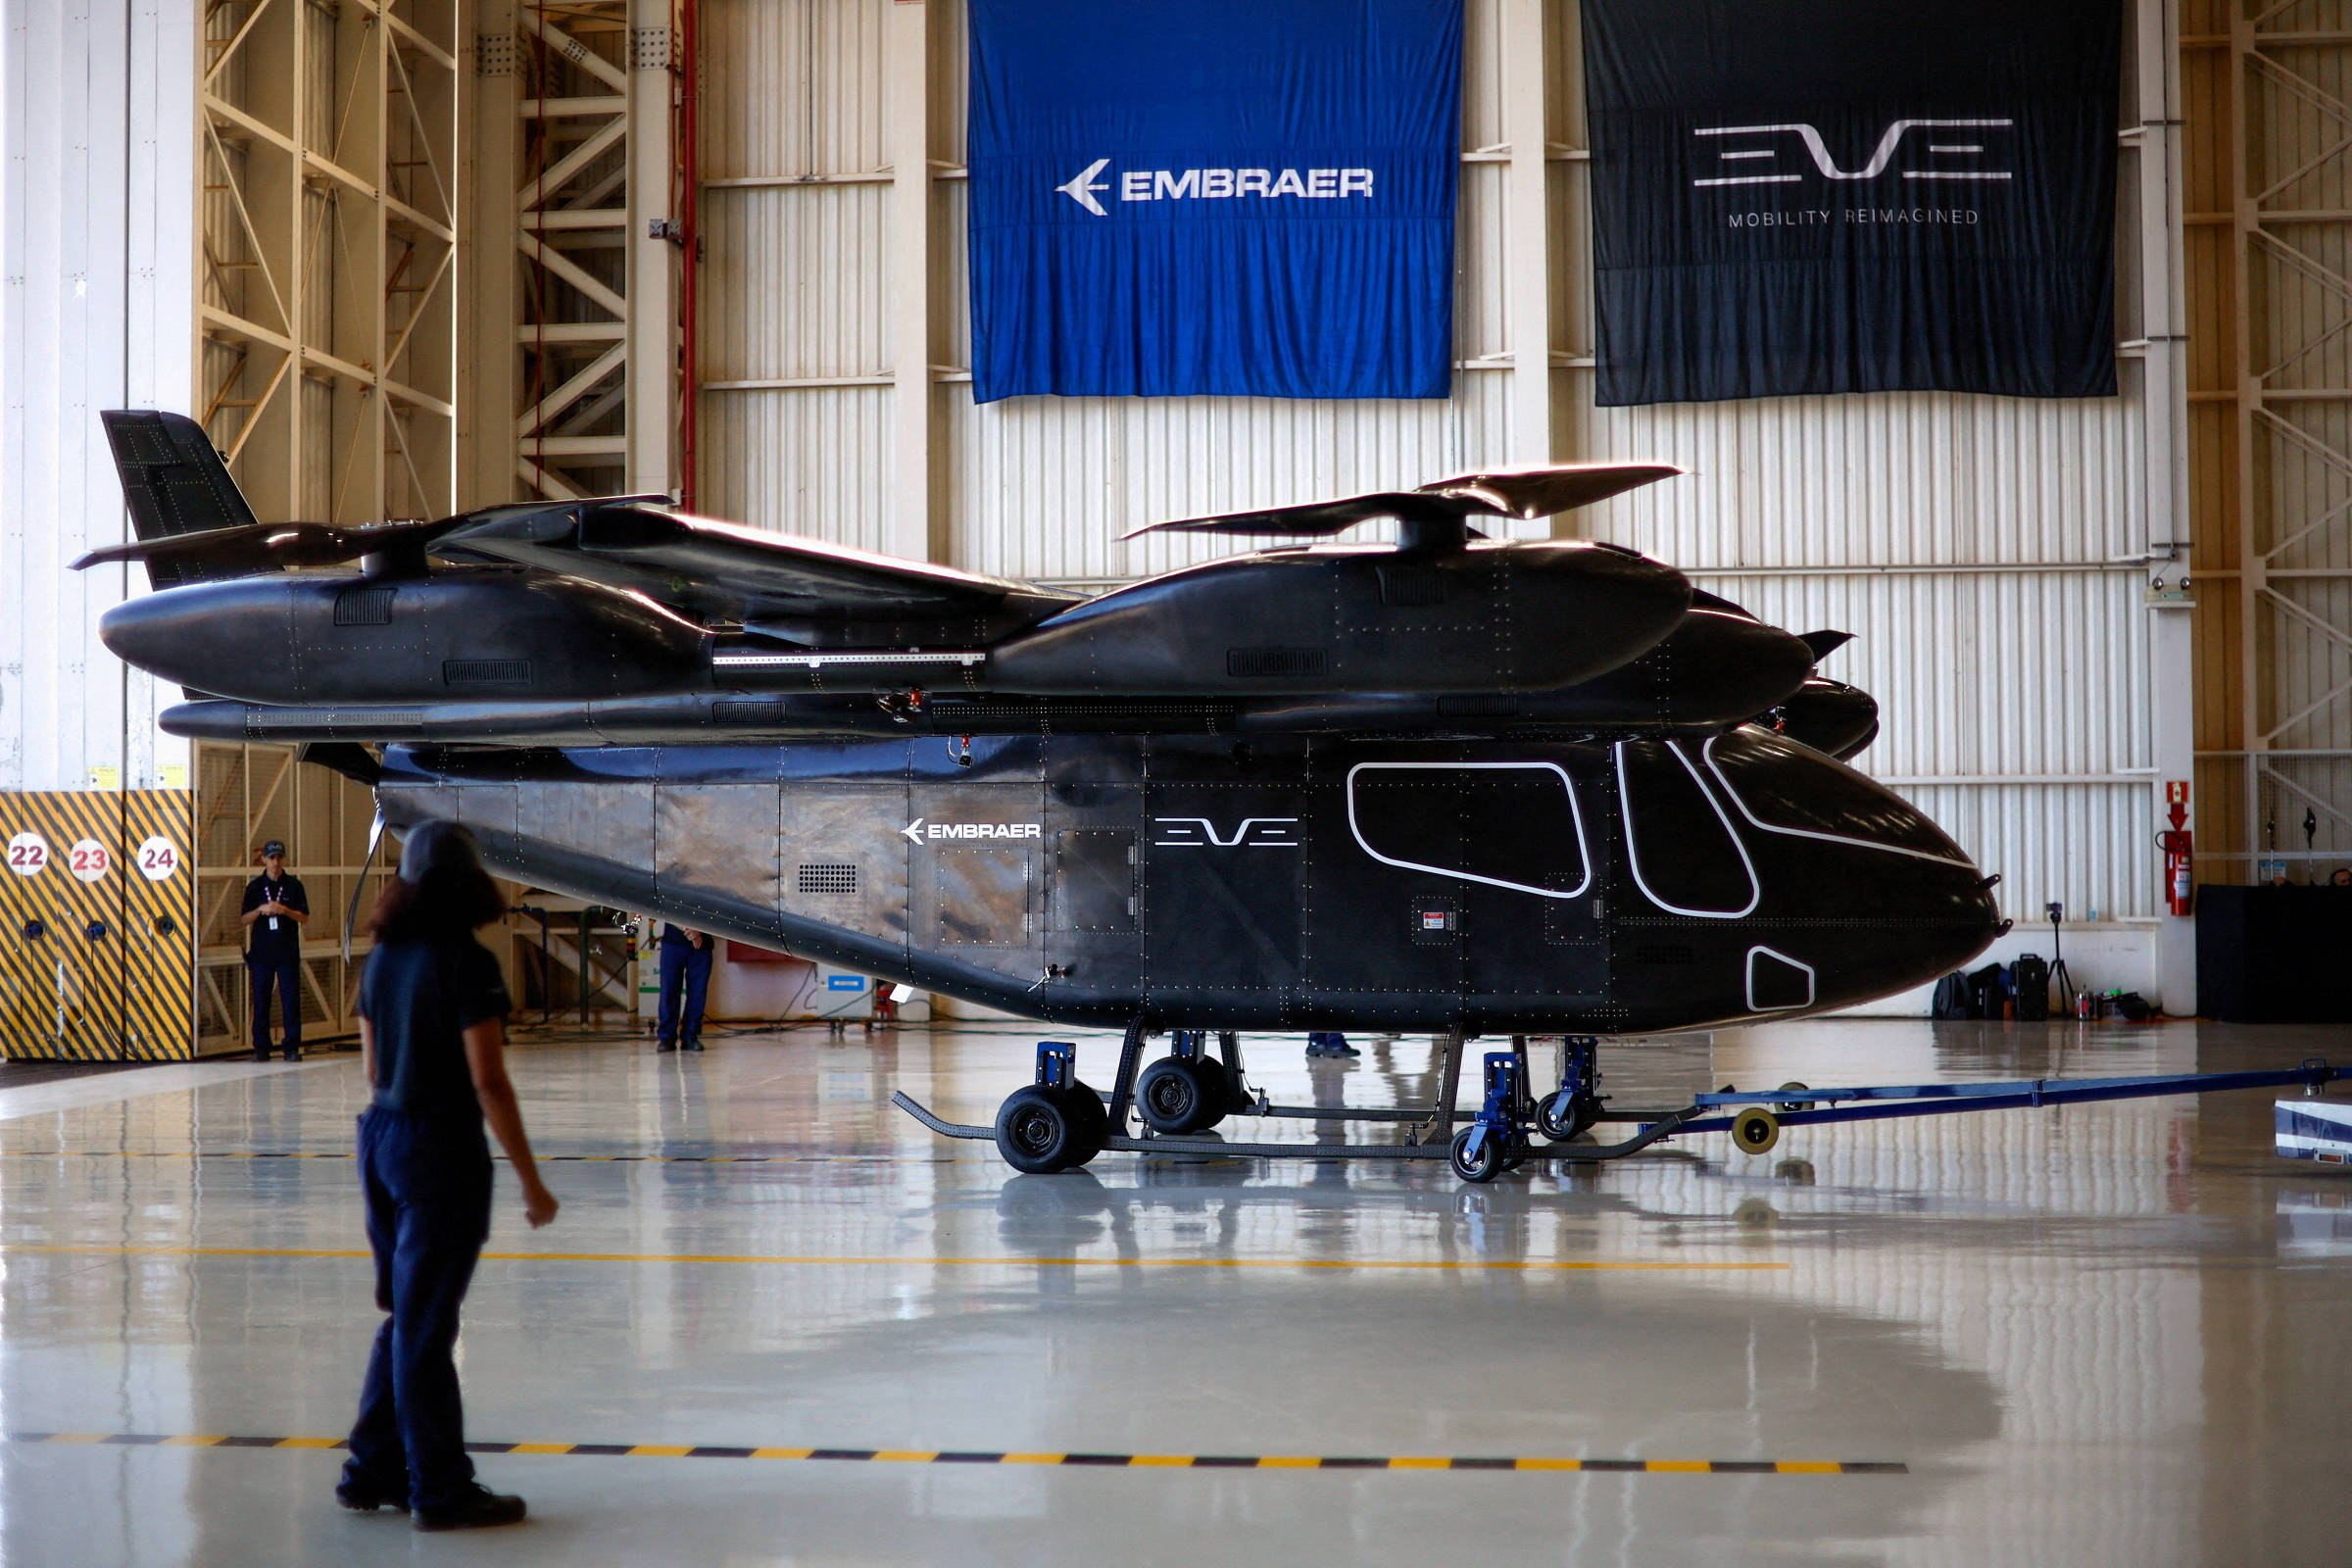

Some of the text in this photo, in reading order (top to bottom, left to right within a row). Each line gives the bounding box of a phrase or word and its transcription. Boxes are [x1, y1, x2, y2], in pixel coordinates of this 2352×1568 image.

[1694, 119, 2013, 186] EVE
[1121, 168, 1374, 201] EMBRAER
[1729, 208, 1979, 228] MOBILITY REIMAGINED
[927, 823, 1041, 839] EMBRAER
[1154, 817, 1298, 846] EVE
[11, 846, 43, 865] 22
[74, 850, 106, 870] 23
[144, 849, 174, 869] 24
